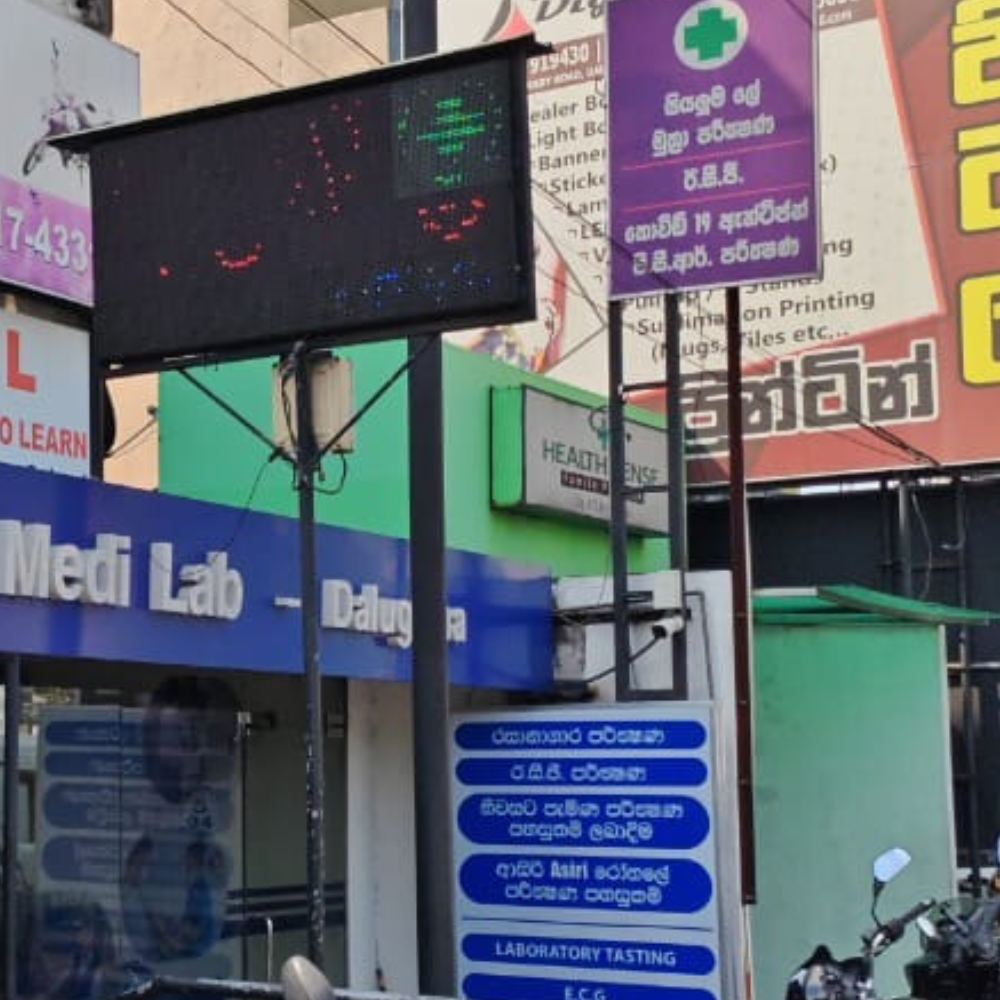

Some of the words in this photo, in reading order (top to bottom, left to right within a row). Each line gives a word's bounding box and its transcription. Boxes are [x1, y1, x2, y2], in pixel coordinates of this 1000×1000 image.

[779, 290, 876, 318] Printing
[6, 328, 38, 394] L
[20, 423, 89, 460] LEARN
[542, 438, 658, 483] HEALTHENSE
[148, 541, 245, 620] Lab
[321, 578, 467, 649] Daluga
[495, 941, 602, 964] LABORATORY
[605, 946, 677, 968] TASTING
